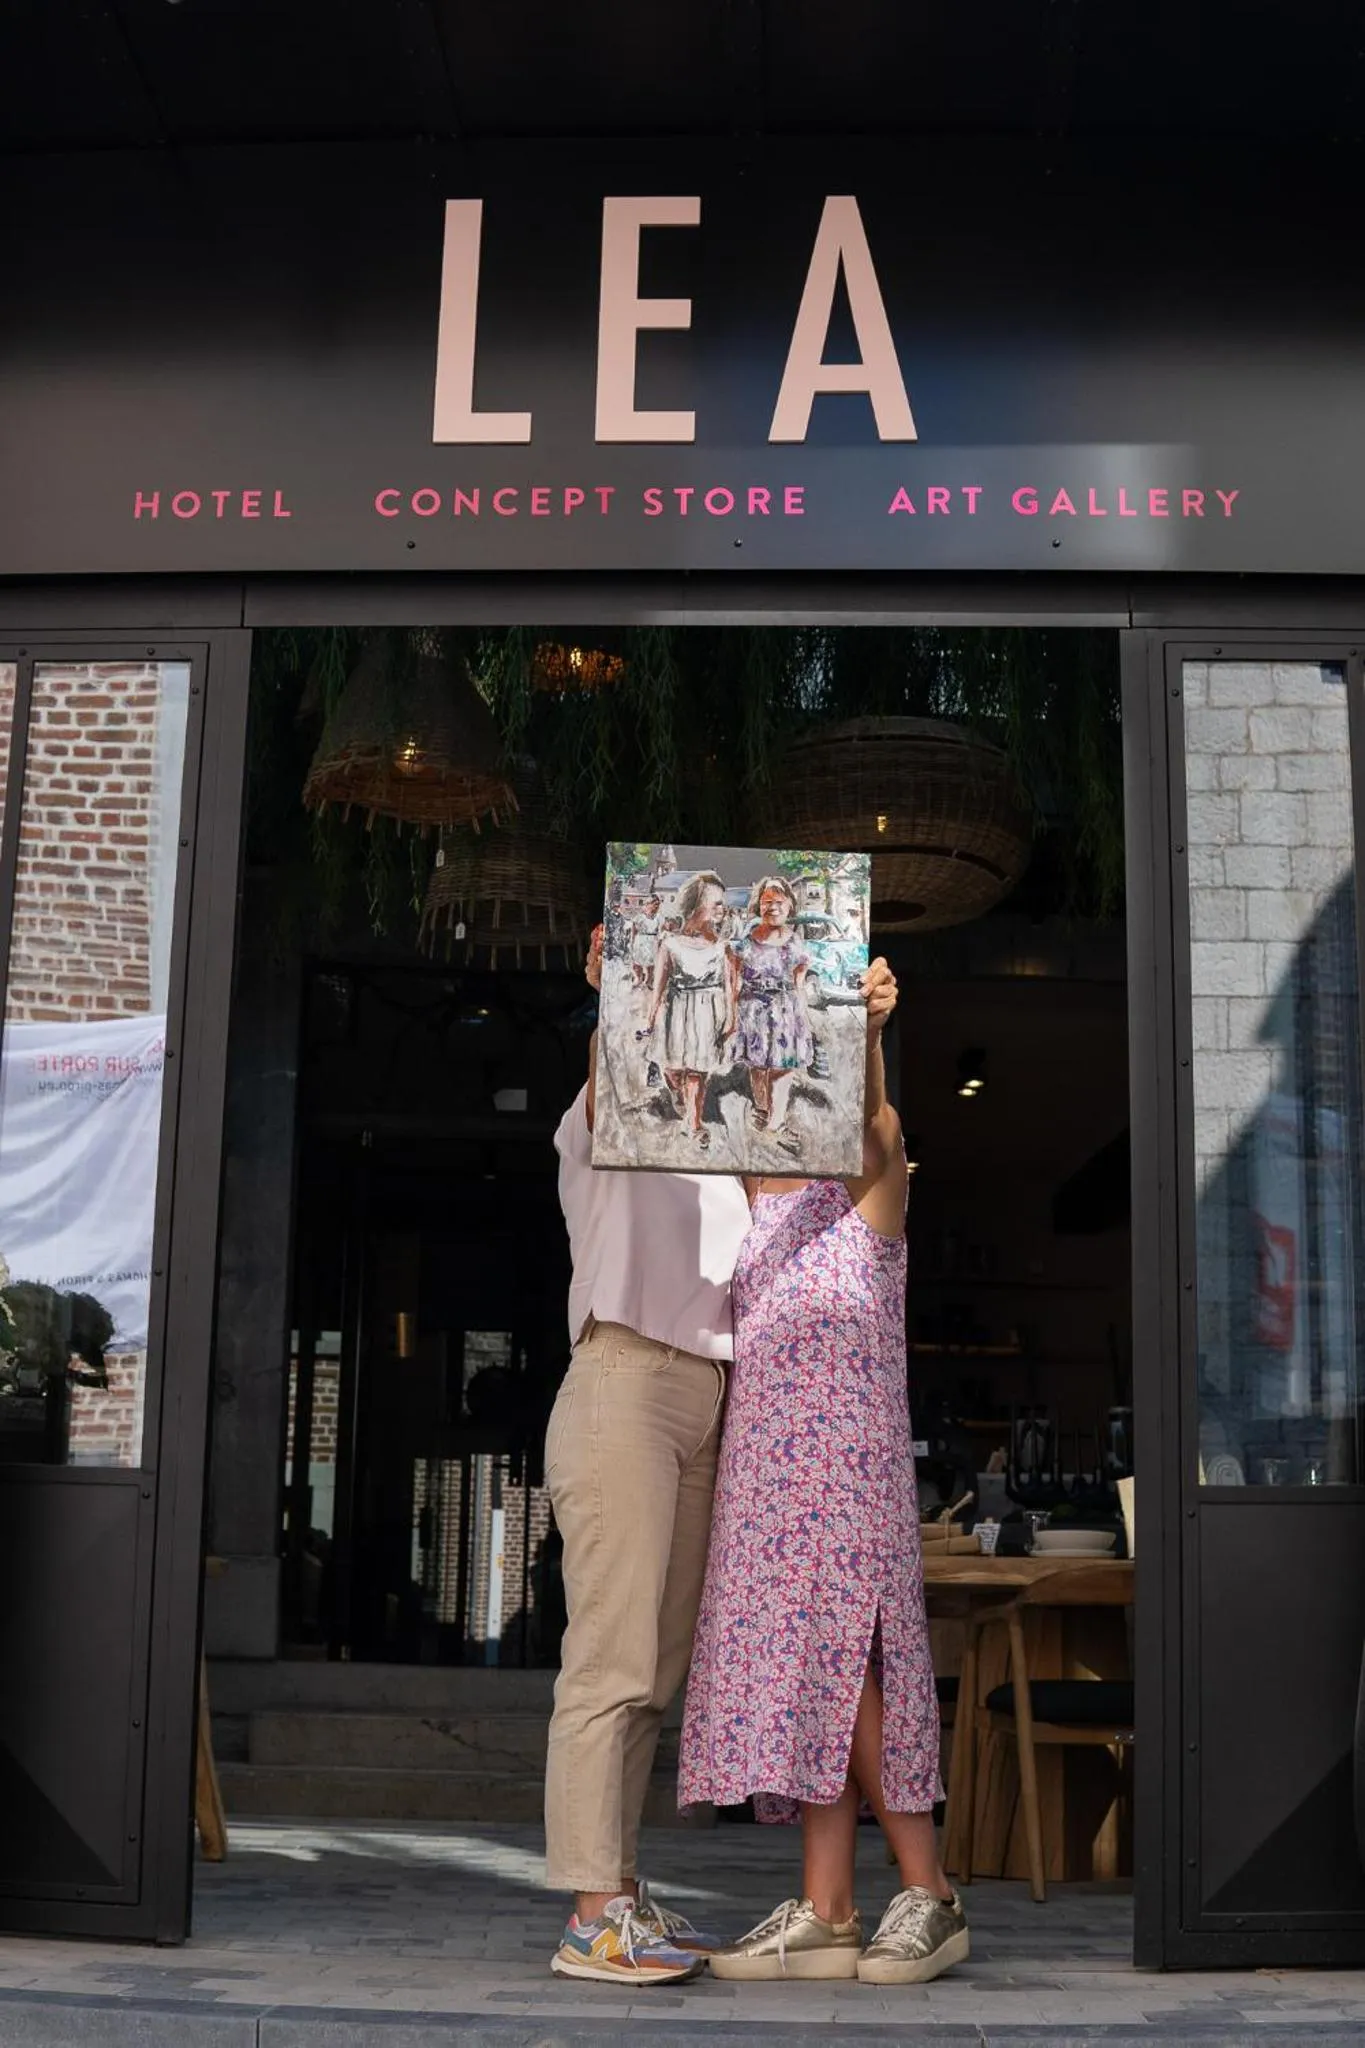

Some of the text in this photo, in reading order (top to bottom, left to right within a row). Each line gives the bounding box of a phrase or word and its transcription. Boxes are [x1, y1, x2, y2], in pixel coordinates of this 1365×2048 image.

[432, 195, 918, 444] LEA
[133, 489, 293, 520] HOTEL
[374, 485, 806, 518] CONCEPT STORE
[888, 486, 1240, 519] ART GALLERY
